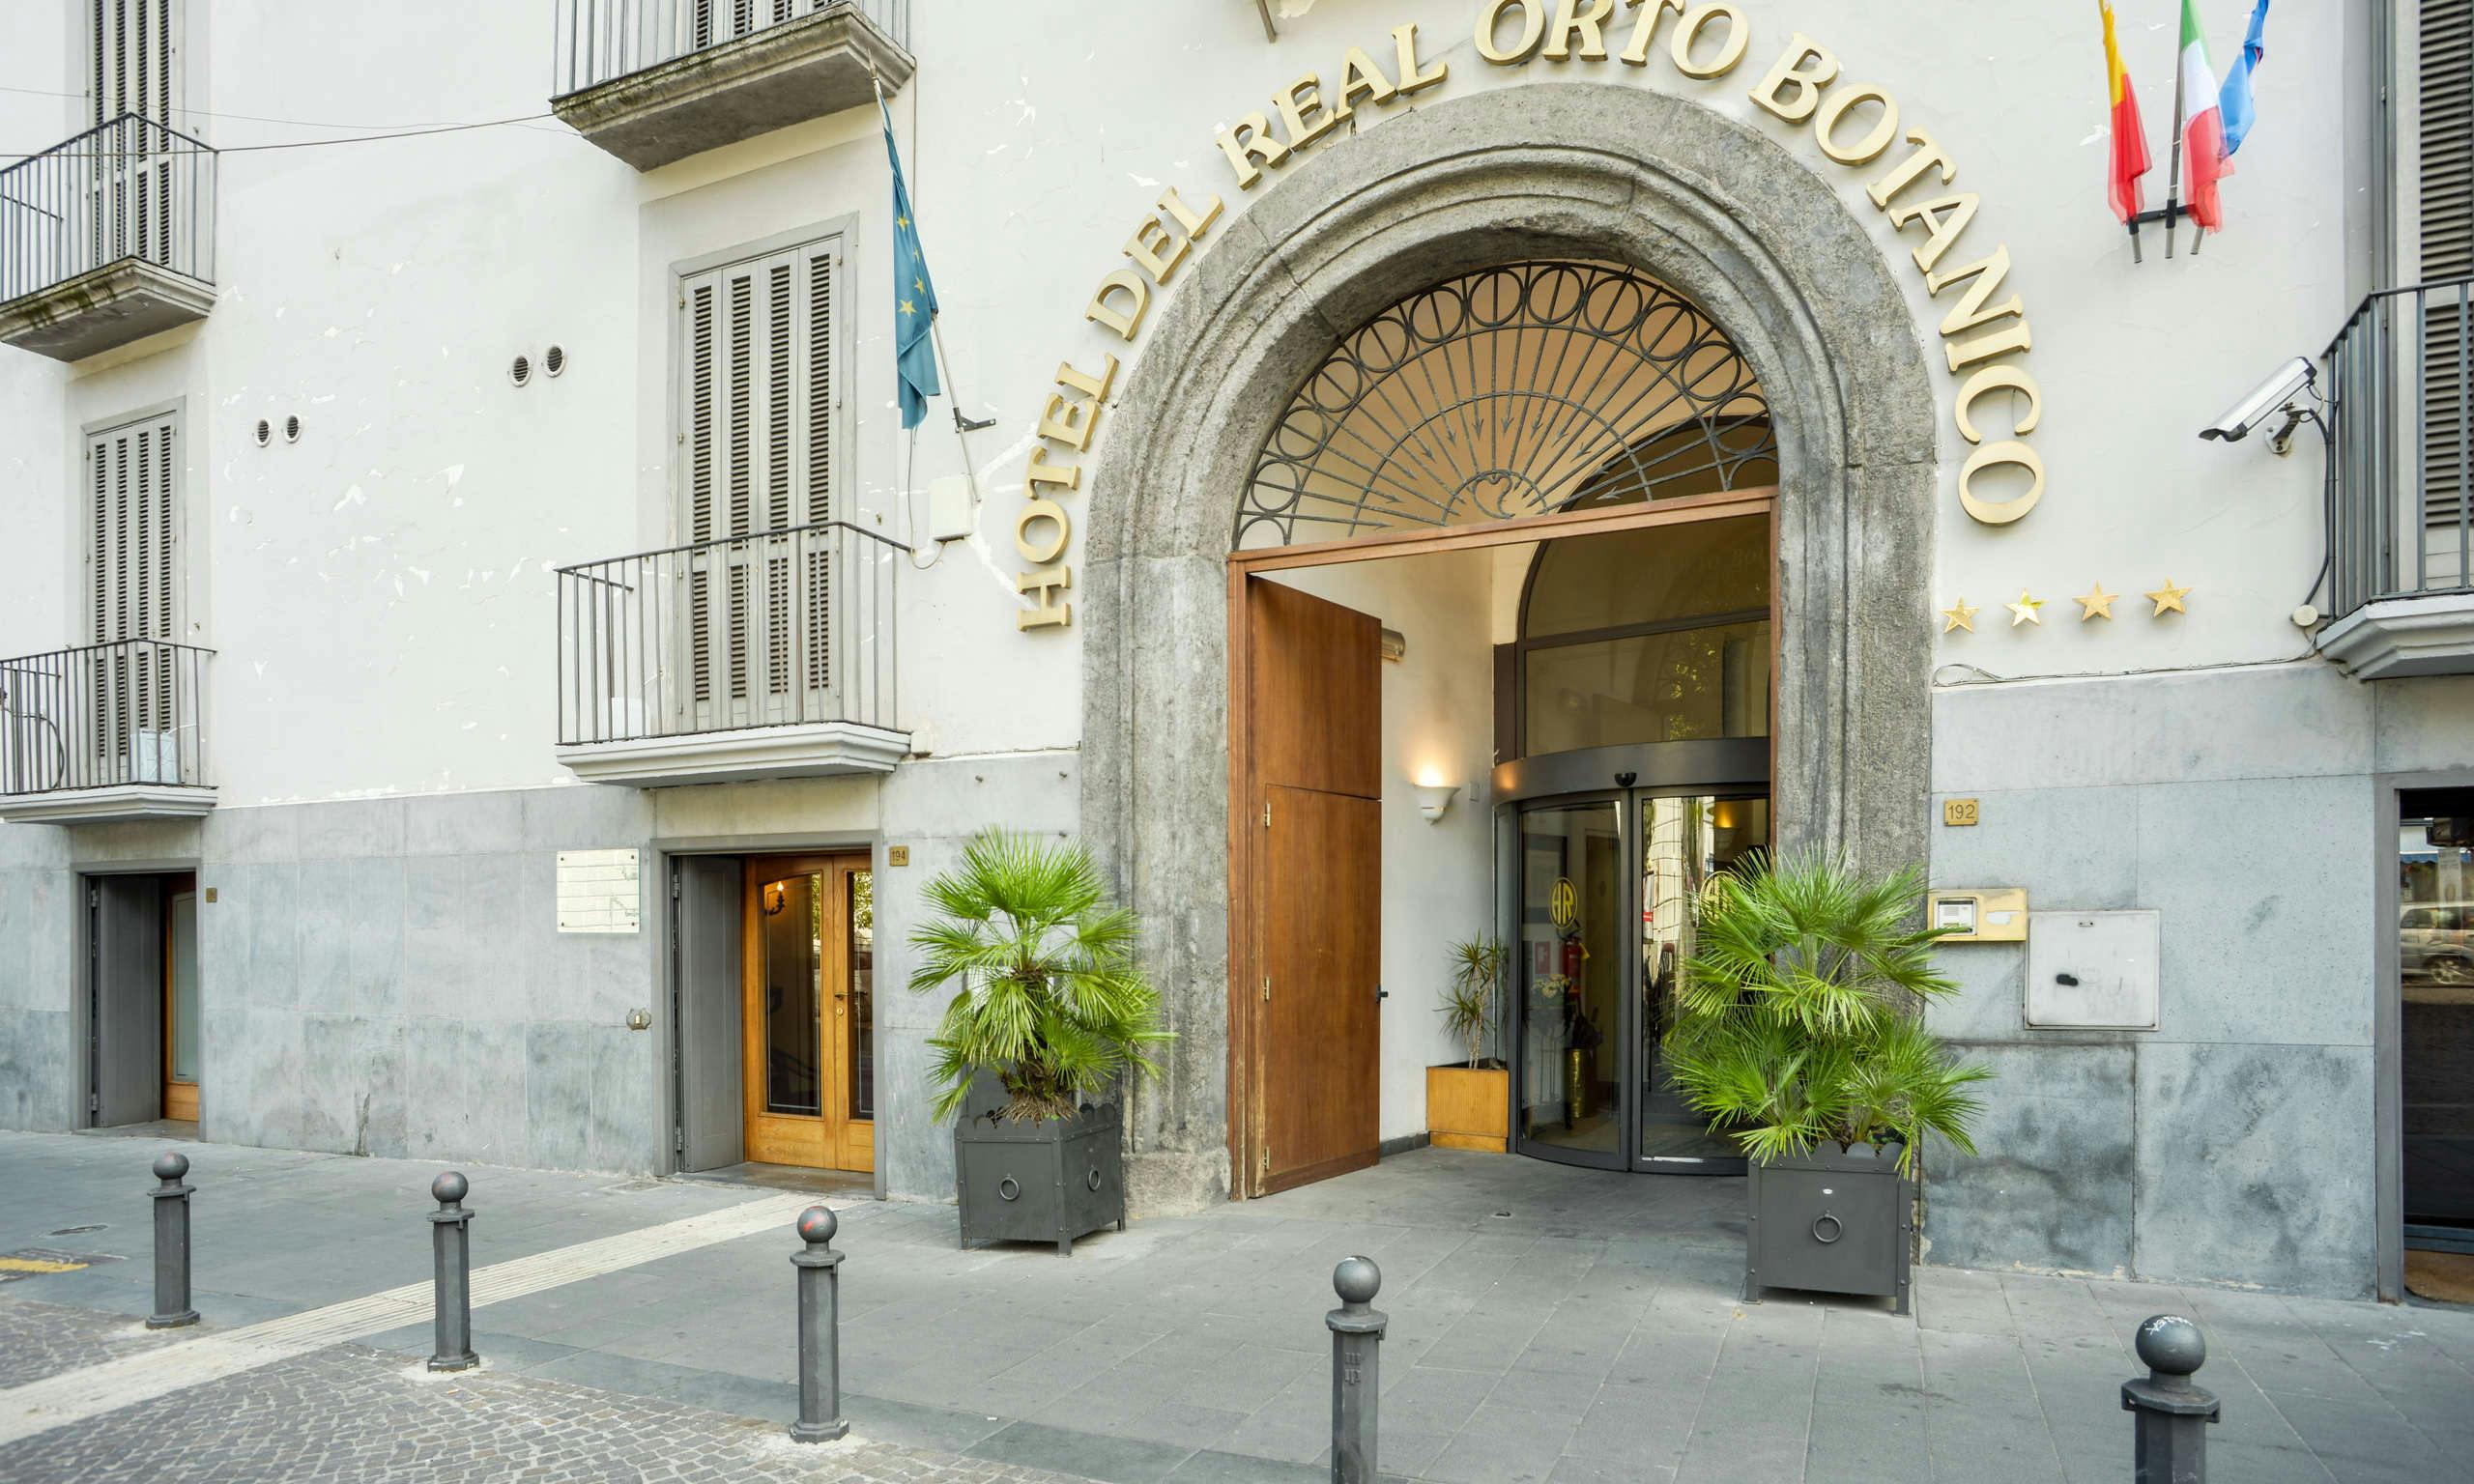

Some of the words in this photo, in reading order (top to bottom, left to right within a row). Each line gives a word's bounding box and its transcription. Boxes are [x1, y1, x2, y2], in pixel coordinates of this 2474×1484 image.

[1015, 353, 1119, 633] HOTEL
[1085, 185, 1224, 343] DEL
[1216, 22, 1450, 191] REAL
[1474, 0, 1749, 80] ORTO
[1748, 32, 2045, 528] BOTANICO
[1947, 803, 1975, 820] 192
[891, 849, 906, 861] 194
